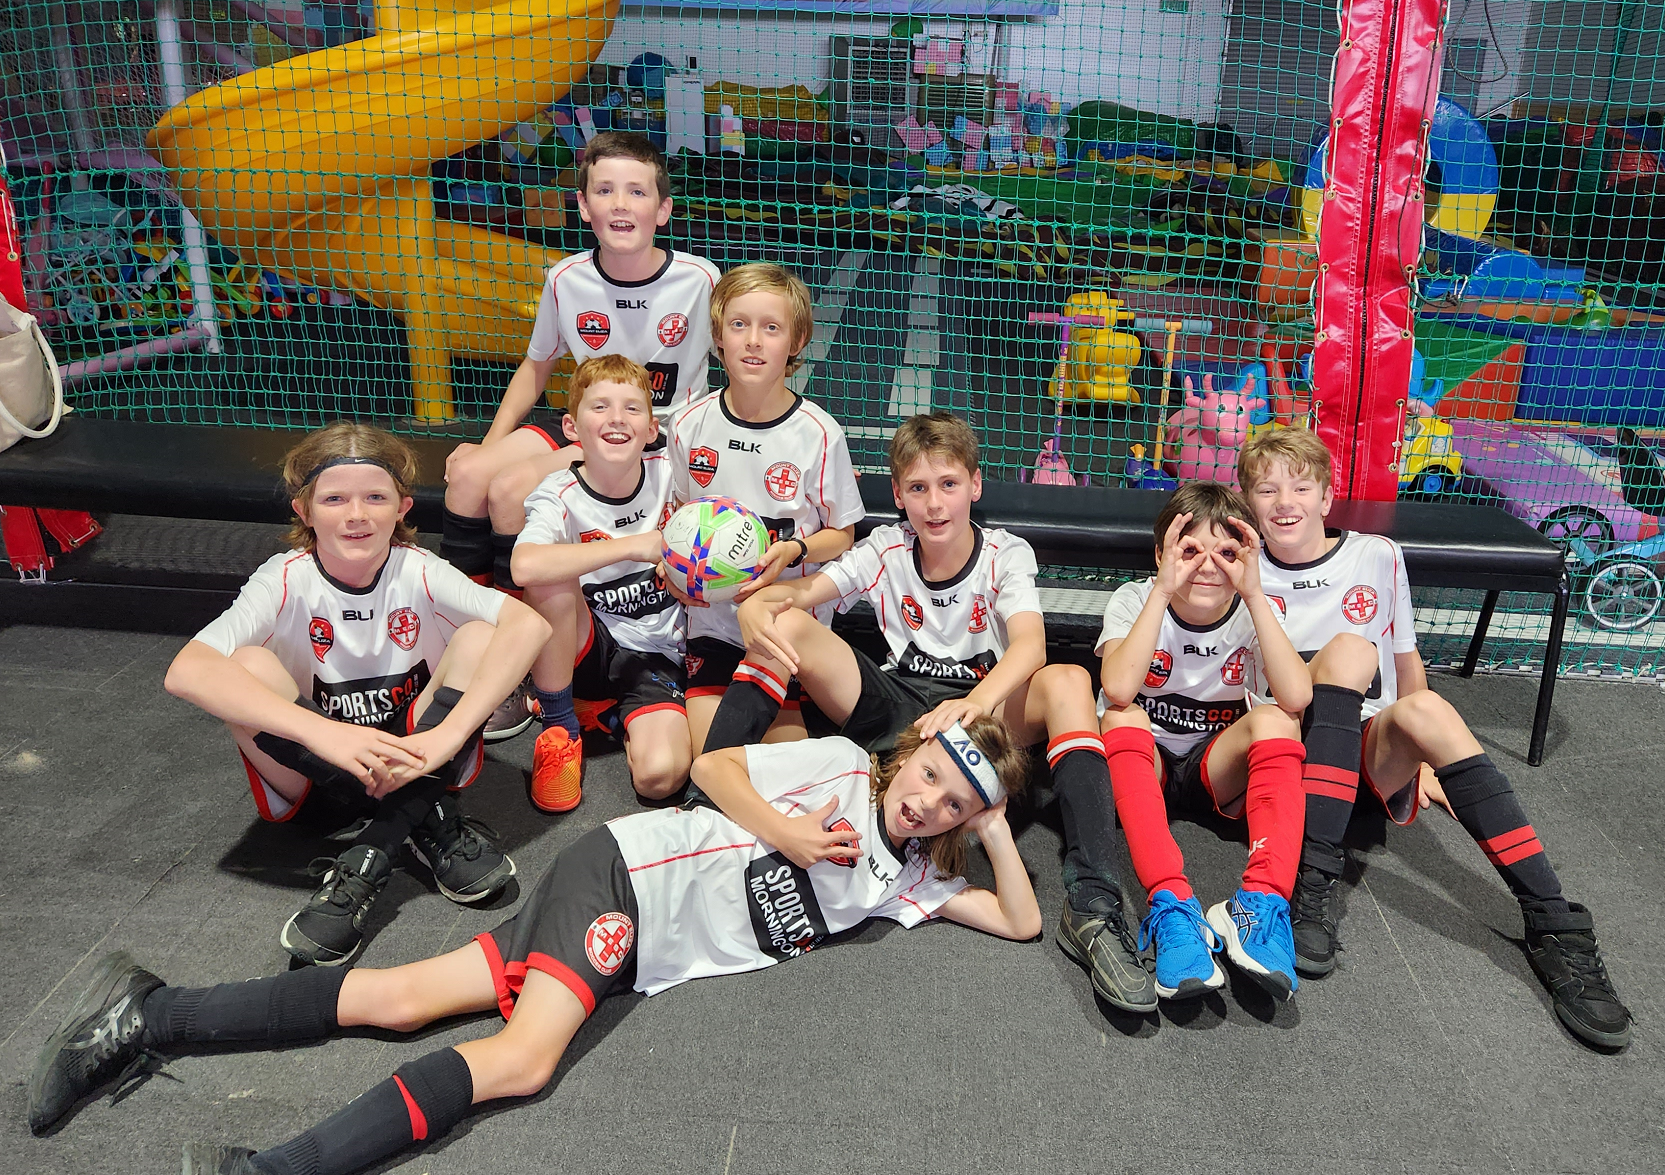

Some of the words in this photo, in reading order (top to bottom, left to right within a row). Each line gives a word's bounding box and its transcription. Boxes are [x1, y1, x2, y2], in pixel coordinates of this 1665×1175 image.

[616, 299, 648, 309] BLK
[728, 439, 762, 454] BLK
[615, 509, 647, 528] BLK
[728, 521, 753, 560] mitre
[1292, 578, 1331, 590] BLK
[931, 594, 960, 608] BLK
[1183, 644, 1219, 657] BLK
[605, 914, 631, 927] MOUNT
